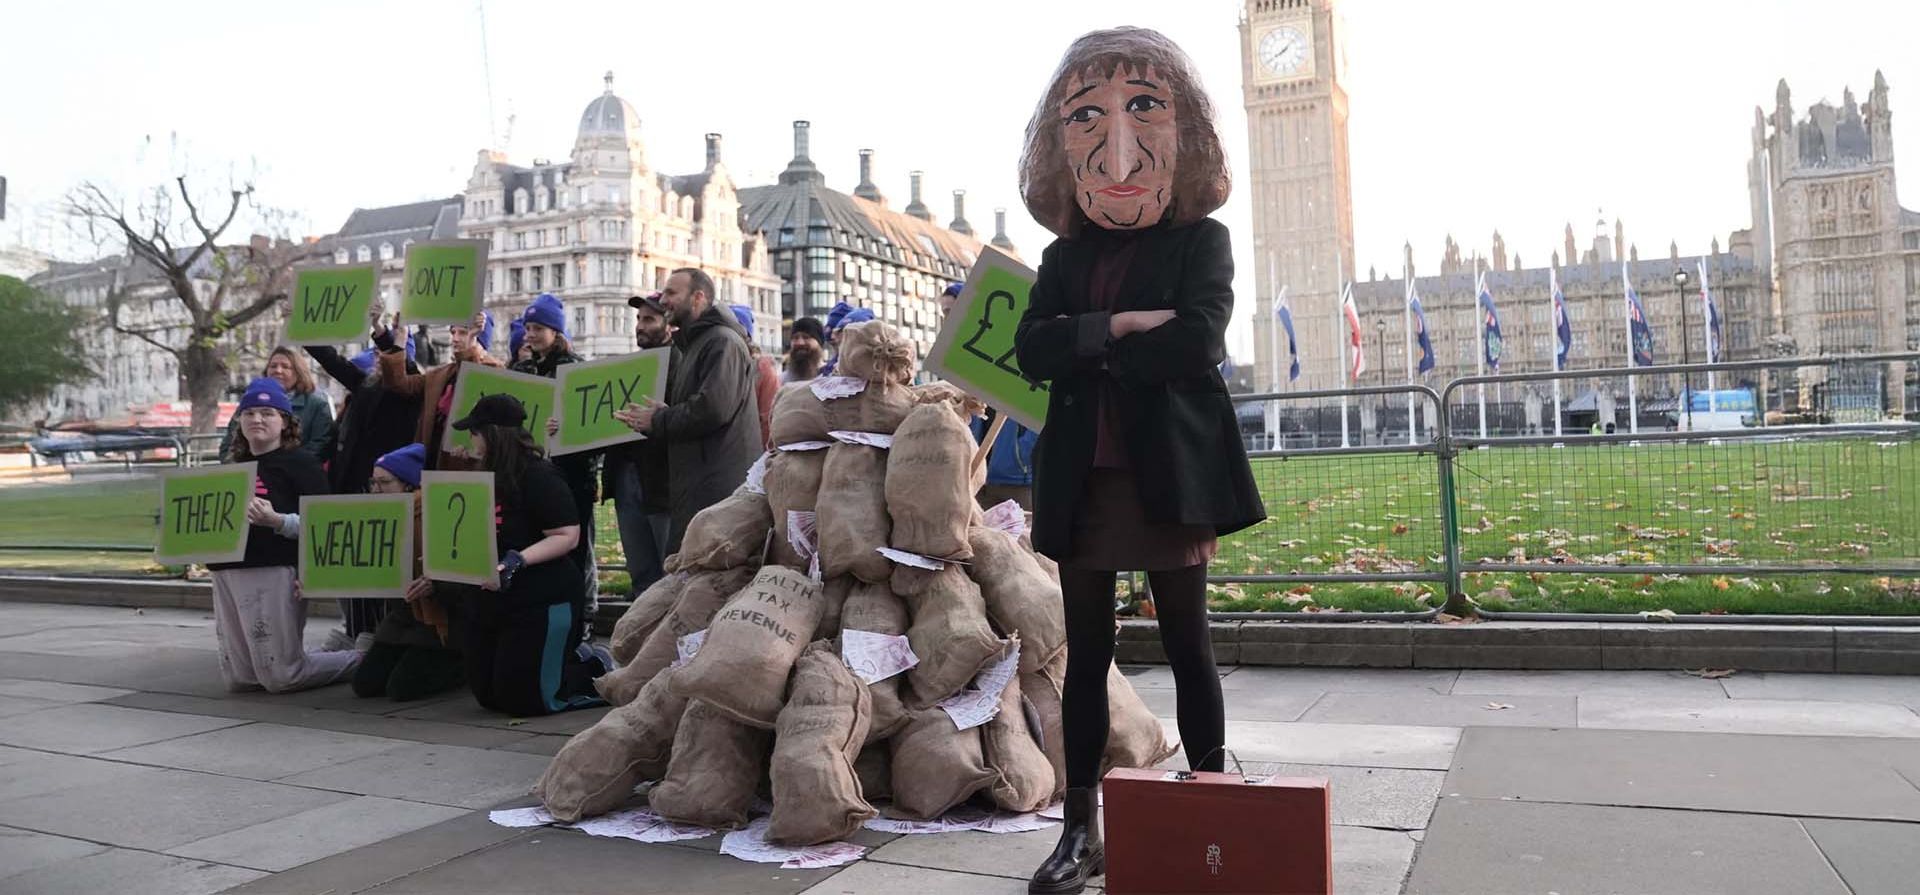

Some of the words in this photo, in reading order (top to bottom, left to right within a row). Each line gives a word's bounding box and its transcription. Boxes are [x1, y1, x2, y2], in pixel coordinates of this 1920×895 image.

[408, 264, 465, 298] ON'T
[303, 284, 358, 324] WHY
[575, 374, 641, 428] TAX
[172, 490, 236, 535] THEIR
[447, 491, 466, 560] ?
[311, 518, 399, 568] WEALTH
[747, 573, 814, 599] EALTH
[757, 591, 791, 613] TAX
